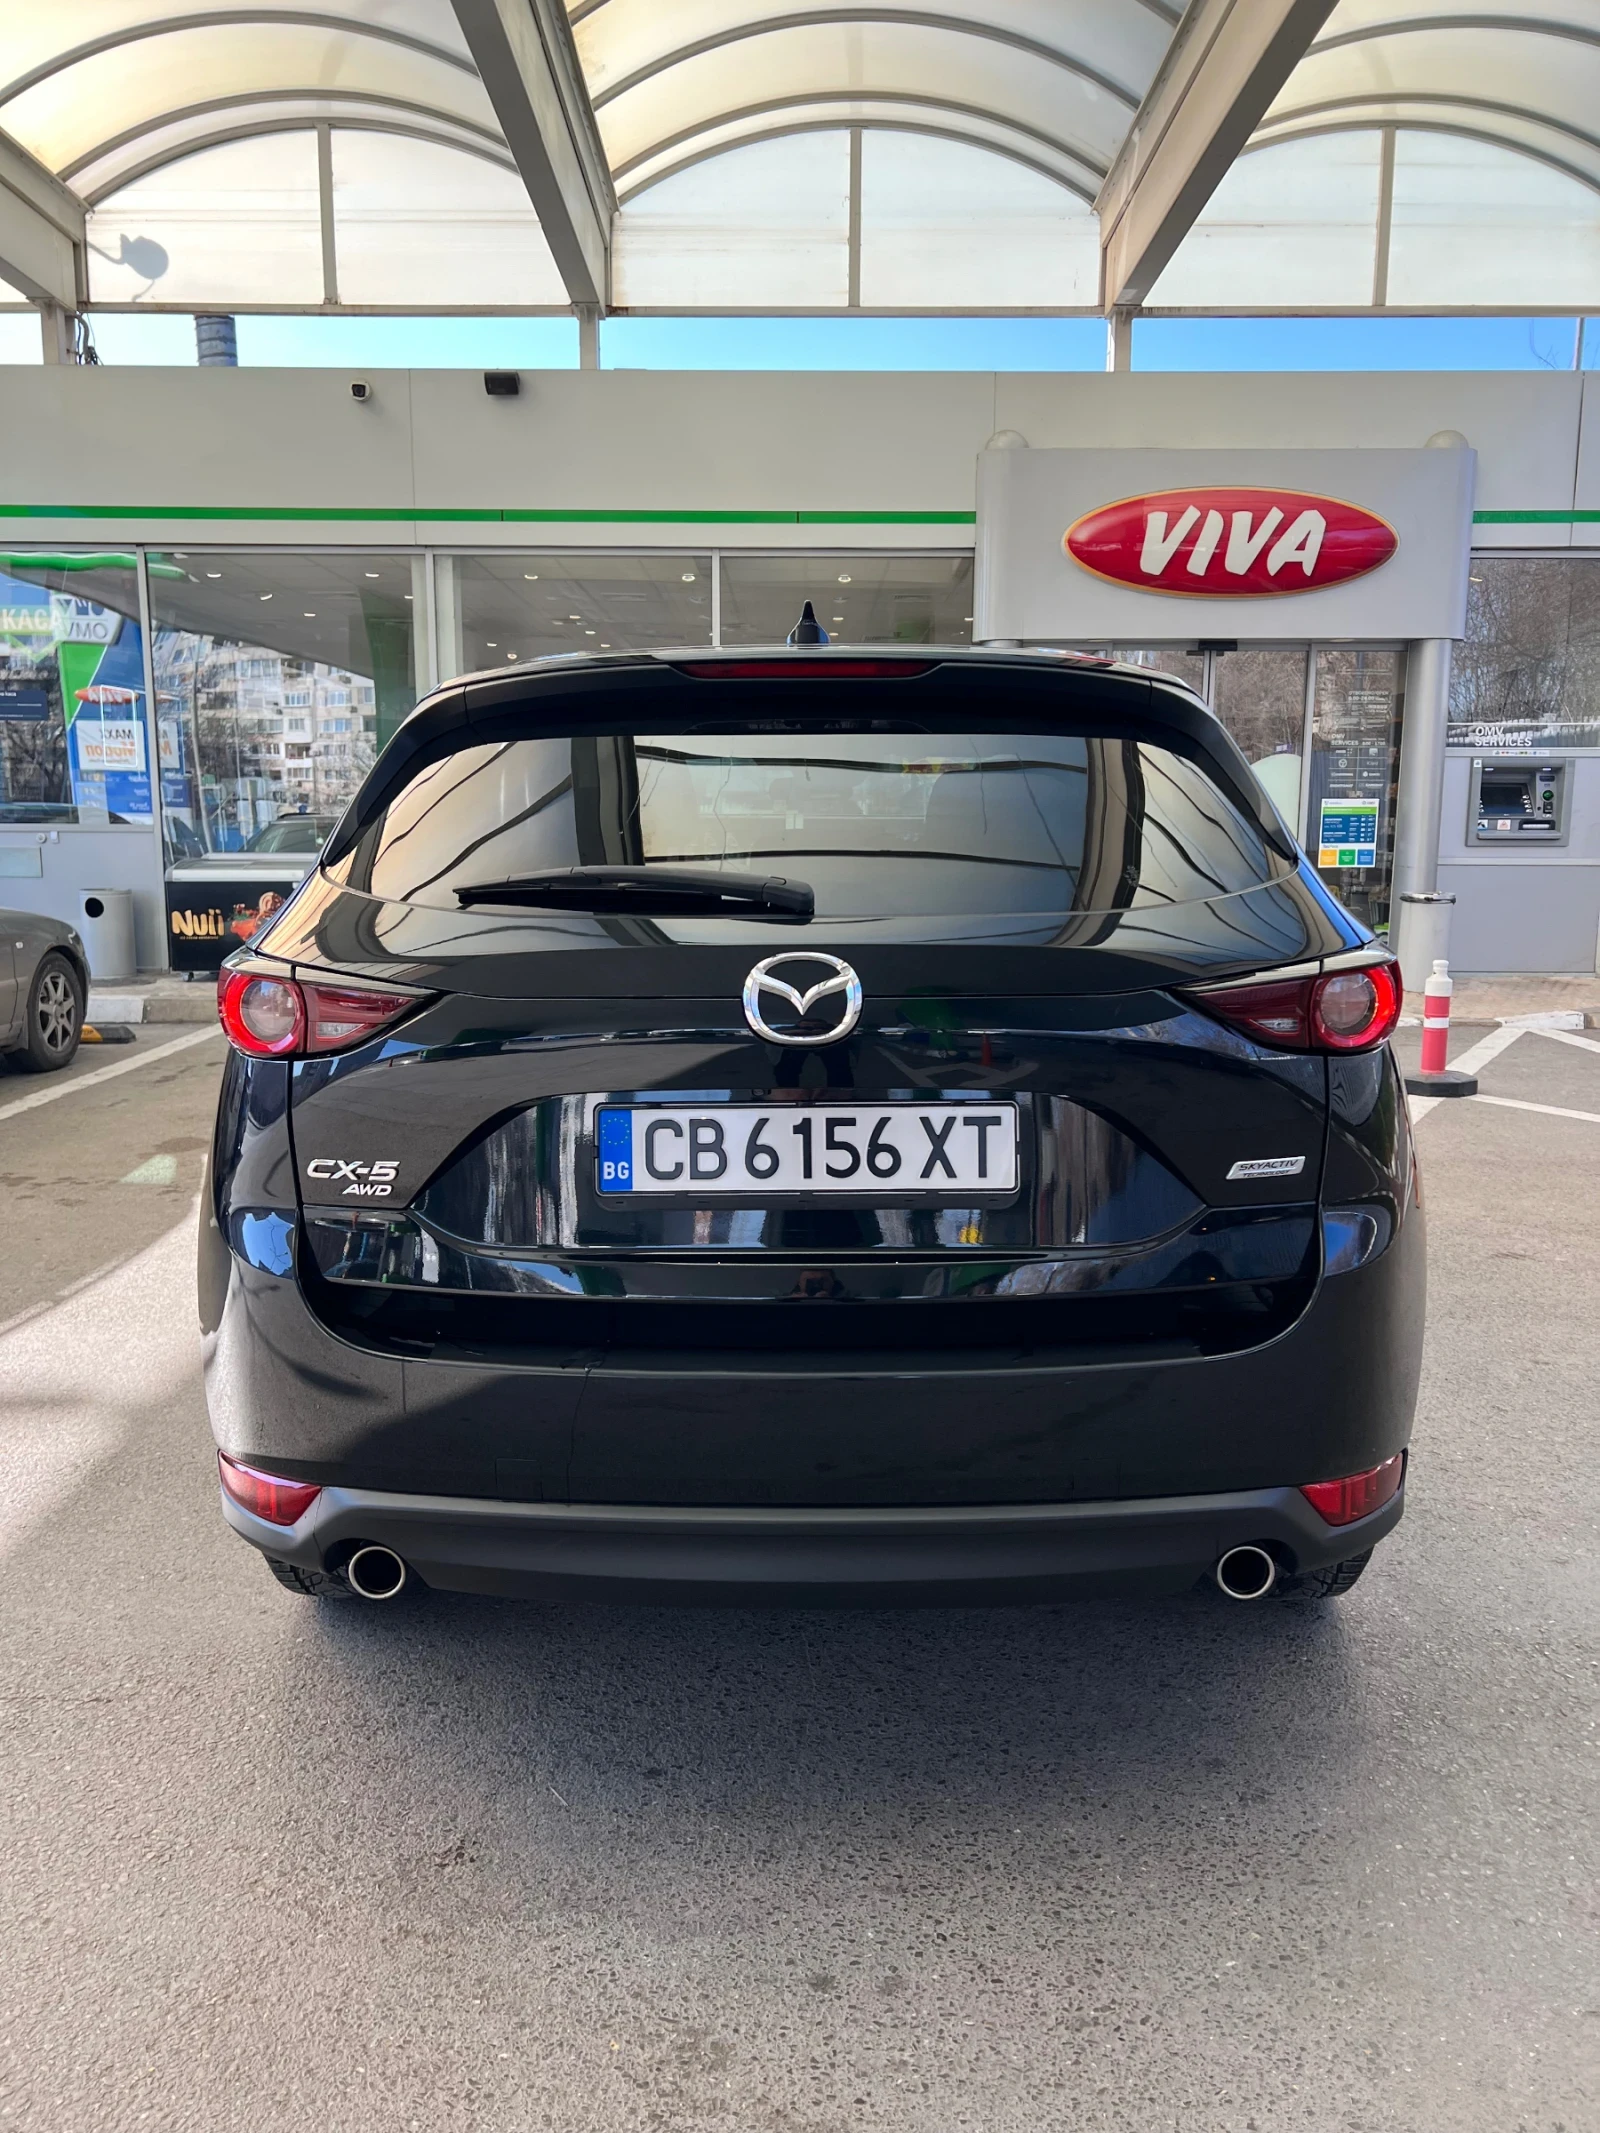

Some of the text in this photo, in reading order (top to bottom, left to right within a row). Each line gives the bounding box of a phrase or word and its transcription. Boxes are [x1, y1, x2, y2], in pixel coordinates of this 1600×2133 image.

[1139, 505, 1326, 576] VIVA
[1475, 726, 1504, 736] OMV
[1474, 736, 1532, 747] SERVICES
[171, 908, 225, 937] Nuii
[604, 1116, 1001, 1180] BG CB 6156 XT
[307, 1159, 400, 1181] CX-5
[1239, 1160, 1298, 1171] SKYACTIV
[342, 1183, 392, 1196] AWD
